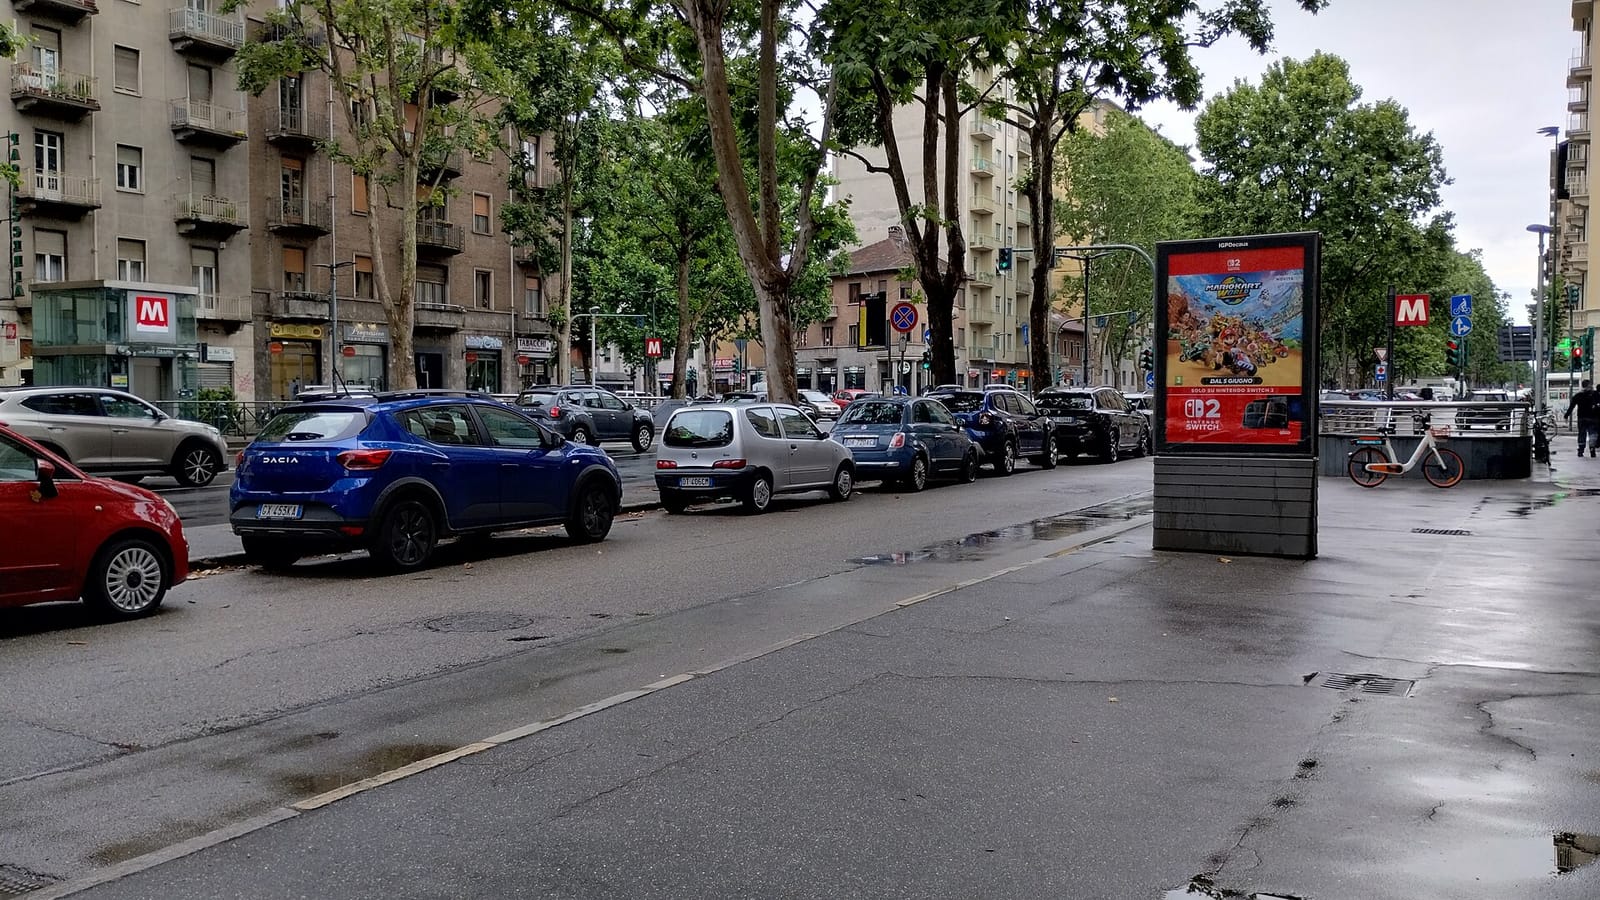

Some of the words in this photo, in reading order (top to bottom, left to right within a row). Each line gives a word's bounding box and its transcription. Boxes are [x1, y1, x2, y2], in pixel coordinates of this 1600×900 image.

[140, 300, 165, 322] M
[1397, 299, 1426, 321] M
[519, 338, 547, 347] TABACCHI
[648, 341, 661, 355] M
[1205, 399, 1221, 418] 2
